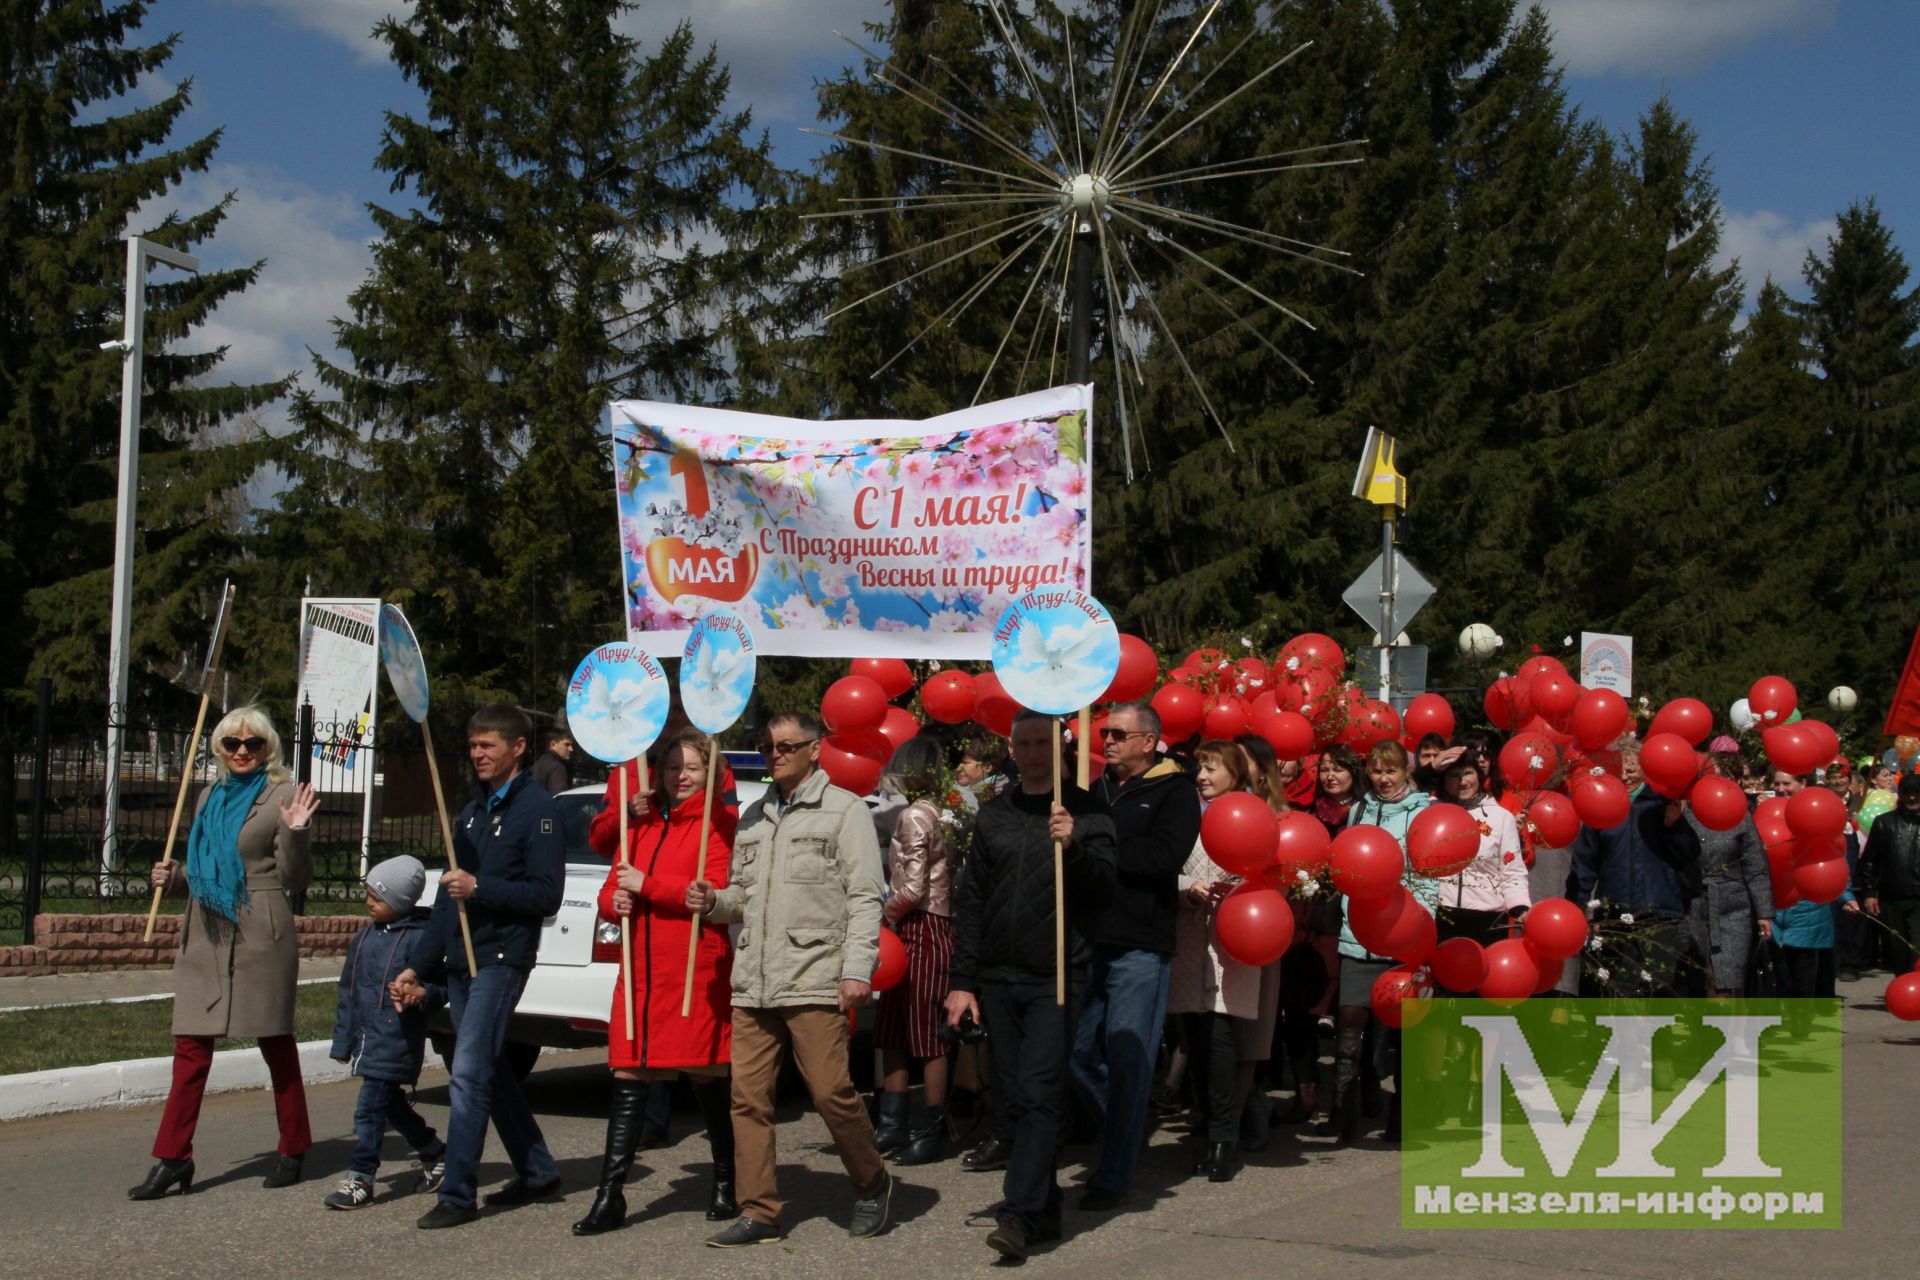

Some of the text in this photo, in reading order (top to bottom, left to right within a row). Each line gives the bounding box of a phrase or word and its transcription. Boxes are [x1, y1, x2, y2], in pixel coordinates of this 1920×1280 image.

[853, 483, 1027, 530] С 1 мая!
[759, 527, 939, 563] С Праздником
[667, 556, 735, 584] МАЯ
[856, 557, 1068, 595] Весны и труда!
[685, 613, 753, 663] Мир! Труд! Май!
[995, 589, 1109, 647] Мир! Труд! Май!
[571, 646, 663, 696] Мир! Труд! Май!
